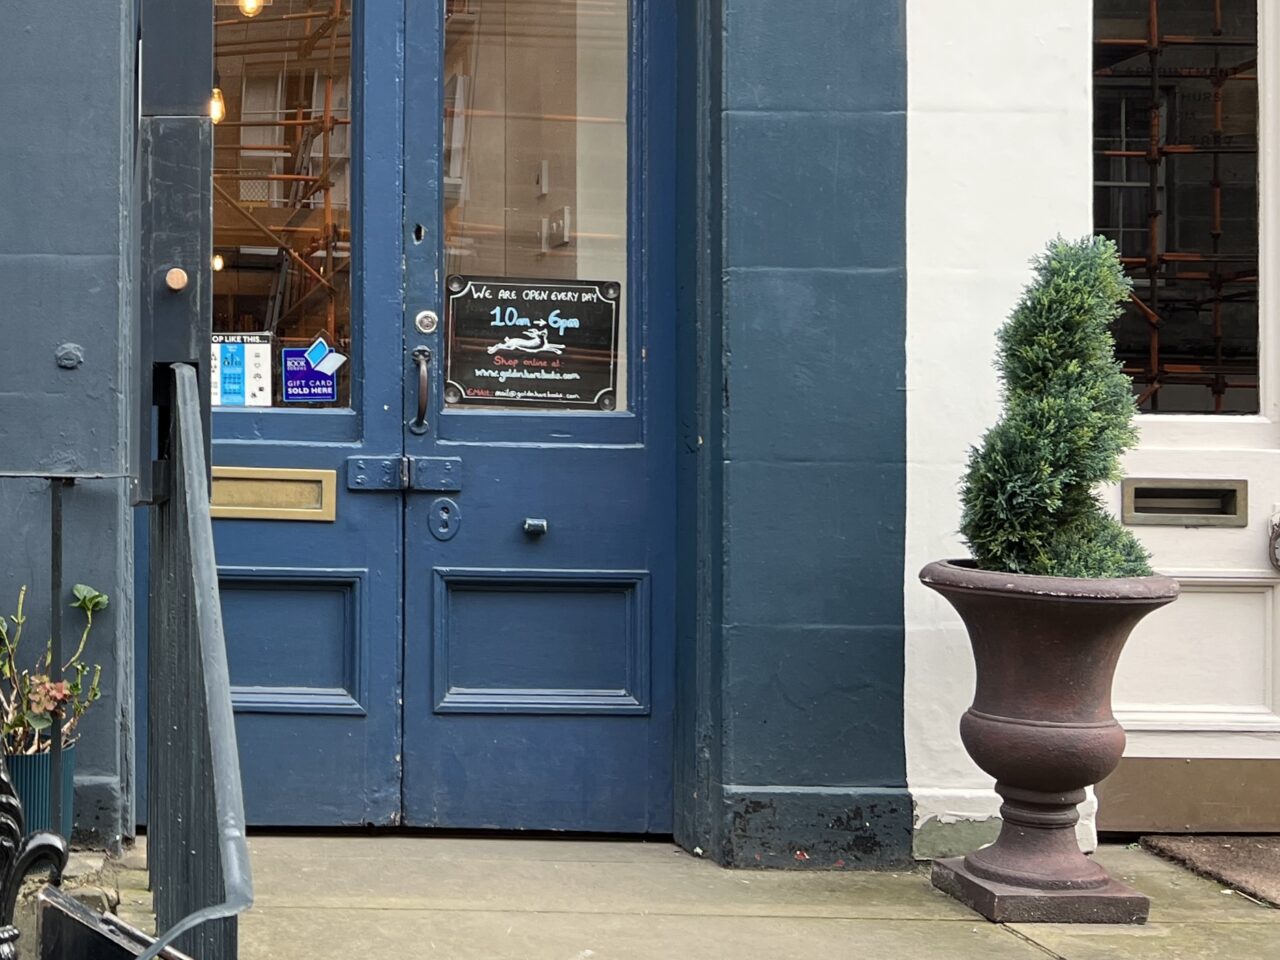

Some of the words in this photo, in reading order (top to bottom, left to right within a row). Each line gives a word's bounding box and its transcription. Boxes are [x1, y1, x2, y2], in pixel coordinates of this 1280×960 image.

[498, 289, 517, 300] ARE
[523, 290, 548, 301] OPEN
[551, 291, 579, 302] EVERY
[581, 292, 598, 303] DAY
[547, 310, 580, 336] 6pm
[493, 355, 519, 367] Shop
[523, 358, 548, 367] online
